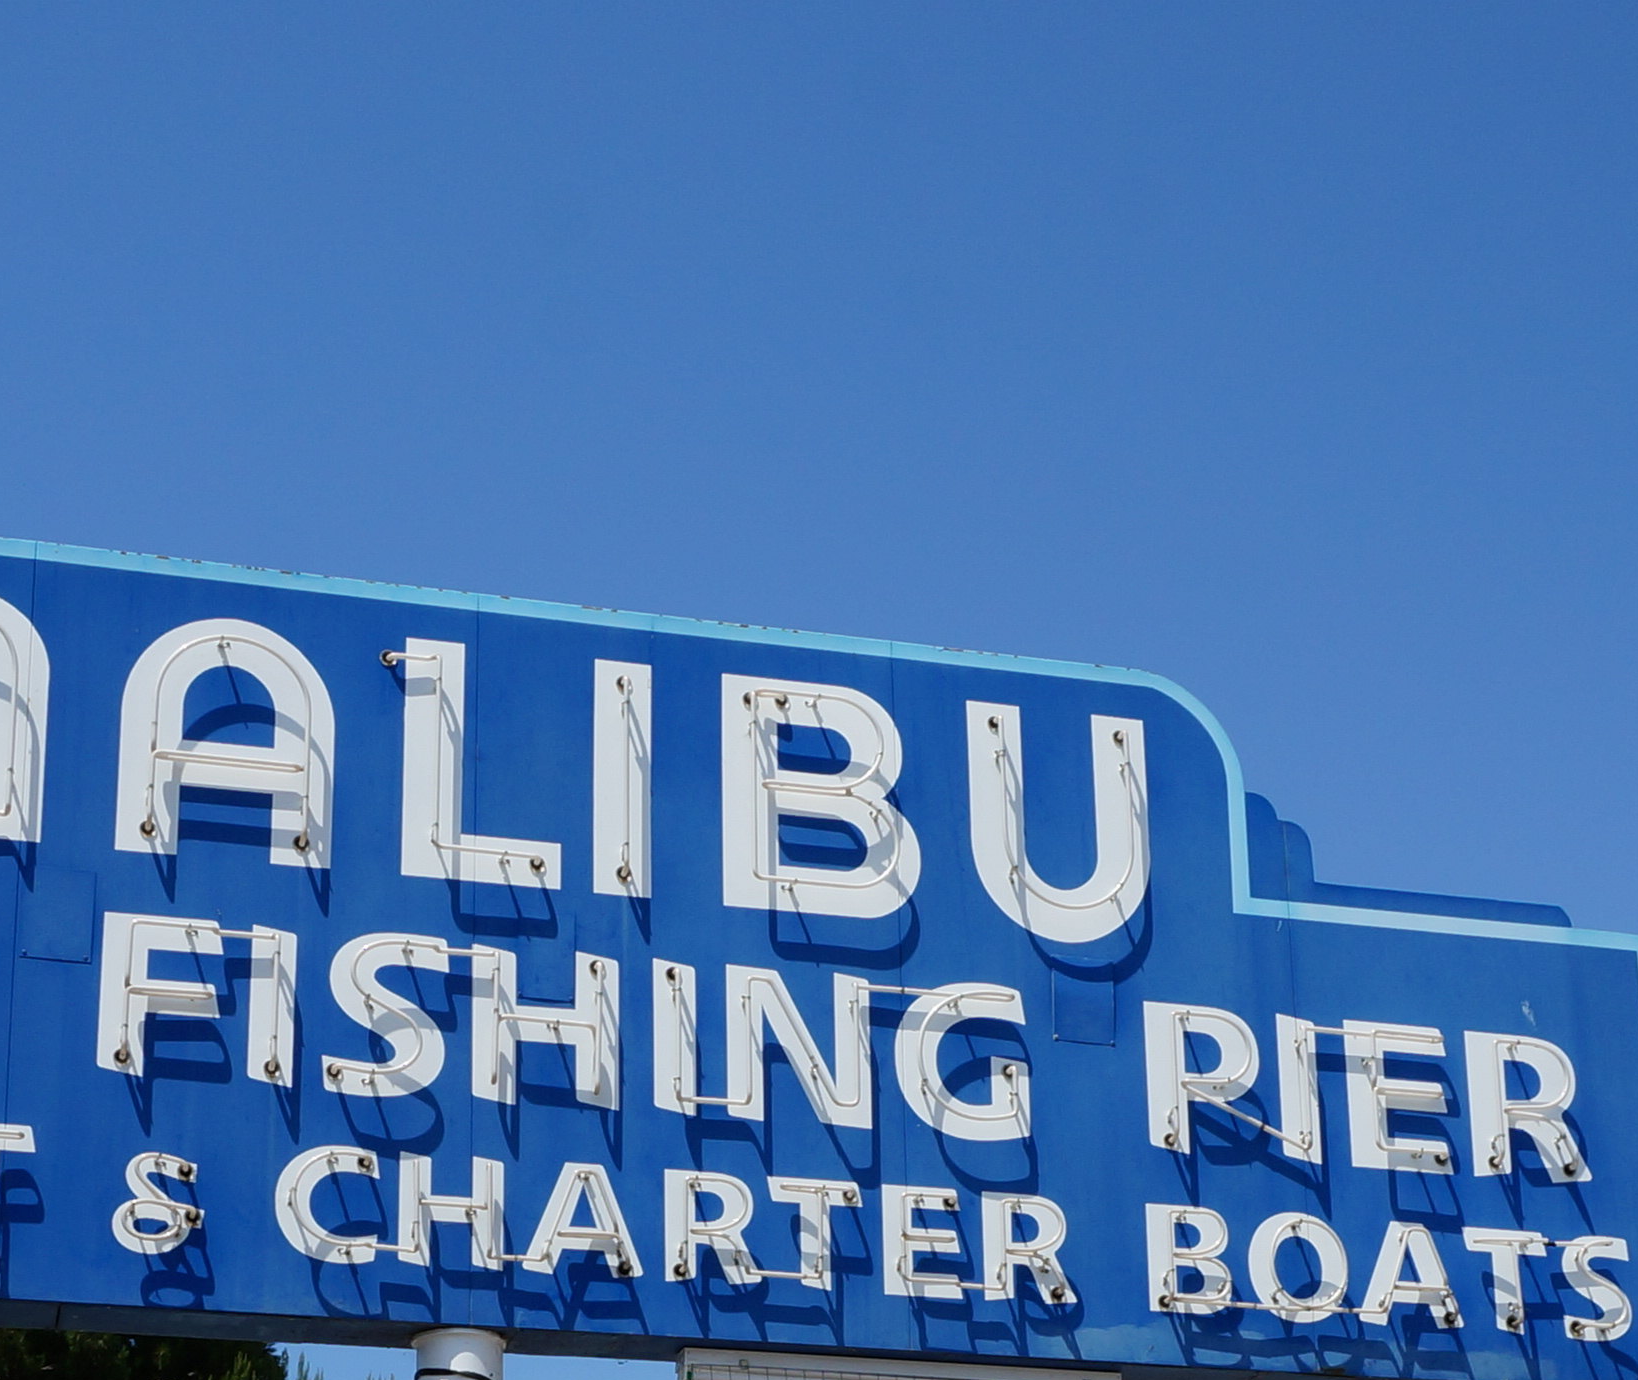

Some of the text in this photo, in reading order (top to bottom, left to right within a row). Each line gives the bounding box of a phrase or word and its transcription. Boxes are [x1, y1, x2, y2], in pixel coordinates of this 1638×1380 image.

[96, 912, 1031, 1141] FISHING
[1143, 1001, 1592, 1183] PIER
[111, 1151, 205, 1254] &
[275, 1145, 1077, 1304] CHARTER
[1145, 1203, 1632, 1342] BOATS
